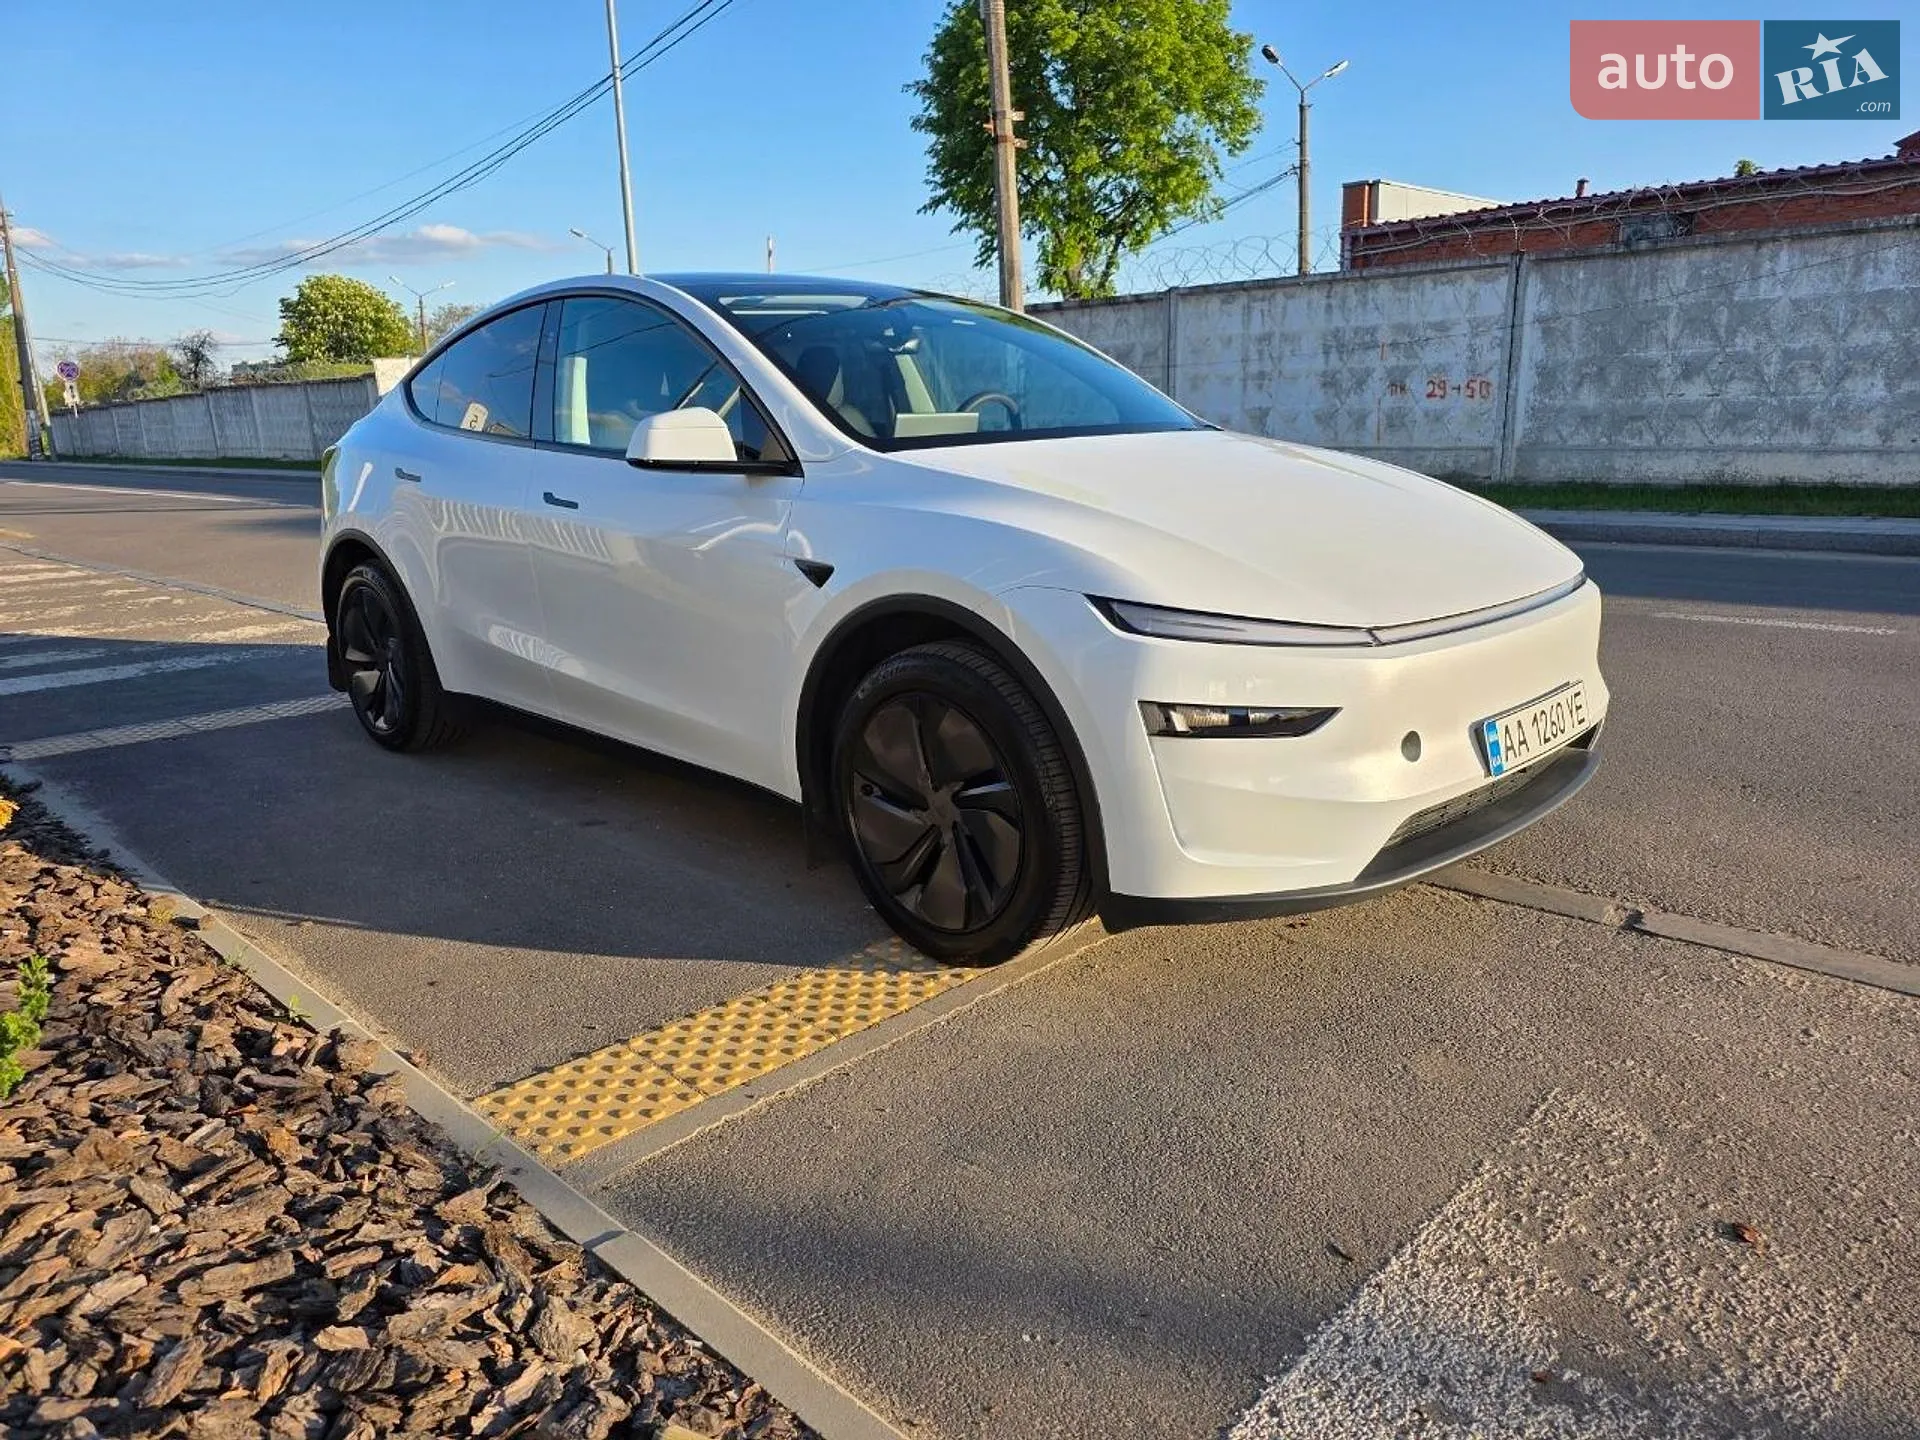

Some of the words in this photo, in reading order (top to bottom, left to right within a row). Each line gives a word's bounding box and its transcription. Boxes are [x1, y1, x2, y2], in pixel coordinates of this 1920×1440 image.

[1504, 720, 1530, 762] AA
[1532, 703, 1566, 746] 1260
[1566, 691, 1585, 729] YE
